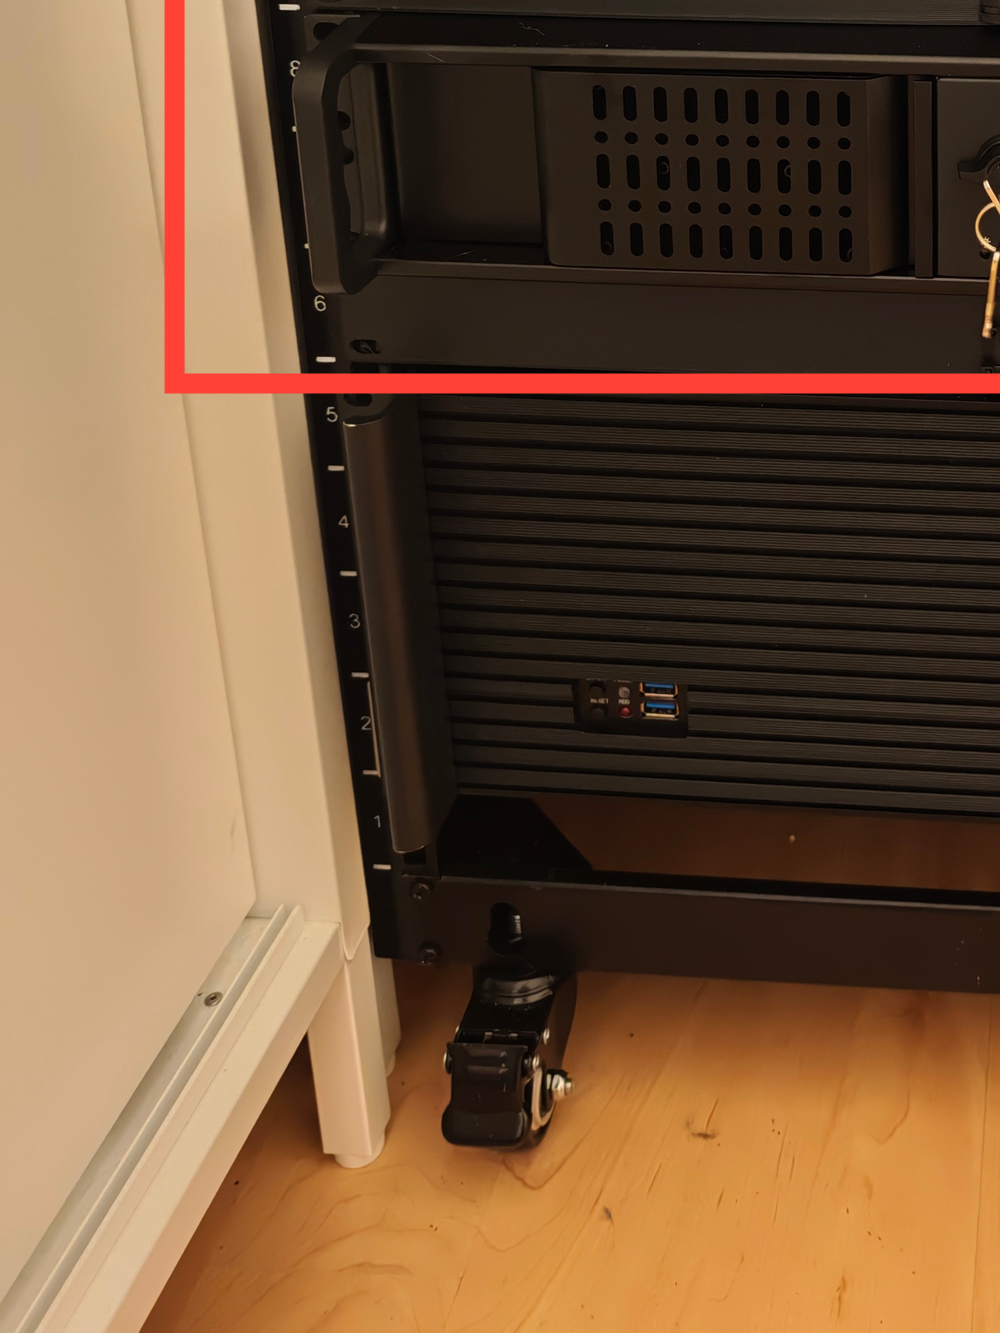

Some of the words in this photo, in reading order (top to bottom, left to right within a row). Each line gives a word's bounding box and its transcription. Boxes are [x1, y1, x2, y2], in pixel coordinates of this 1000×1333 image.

[313, 294, 327, 312] 6
[325, 406, 339, 423] 5
[338, 514, 350, 529] 4
[349, 612, 361, 629] 3
[360, 715, 372, 731] 2
[374, 814, 381, 829] 1
